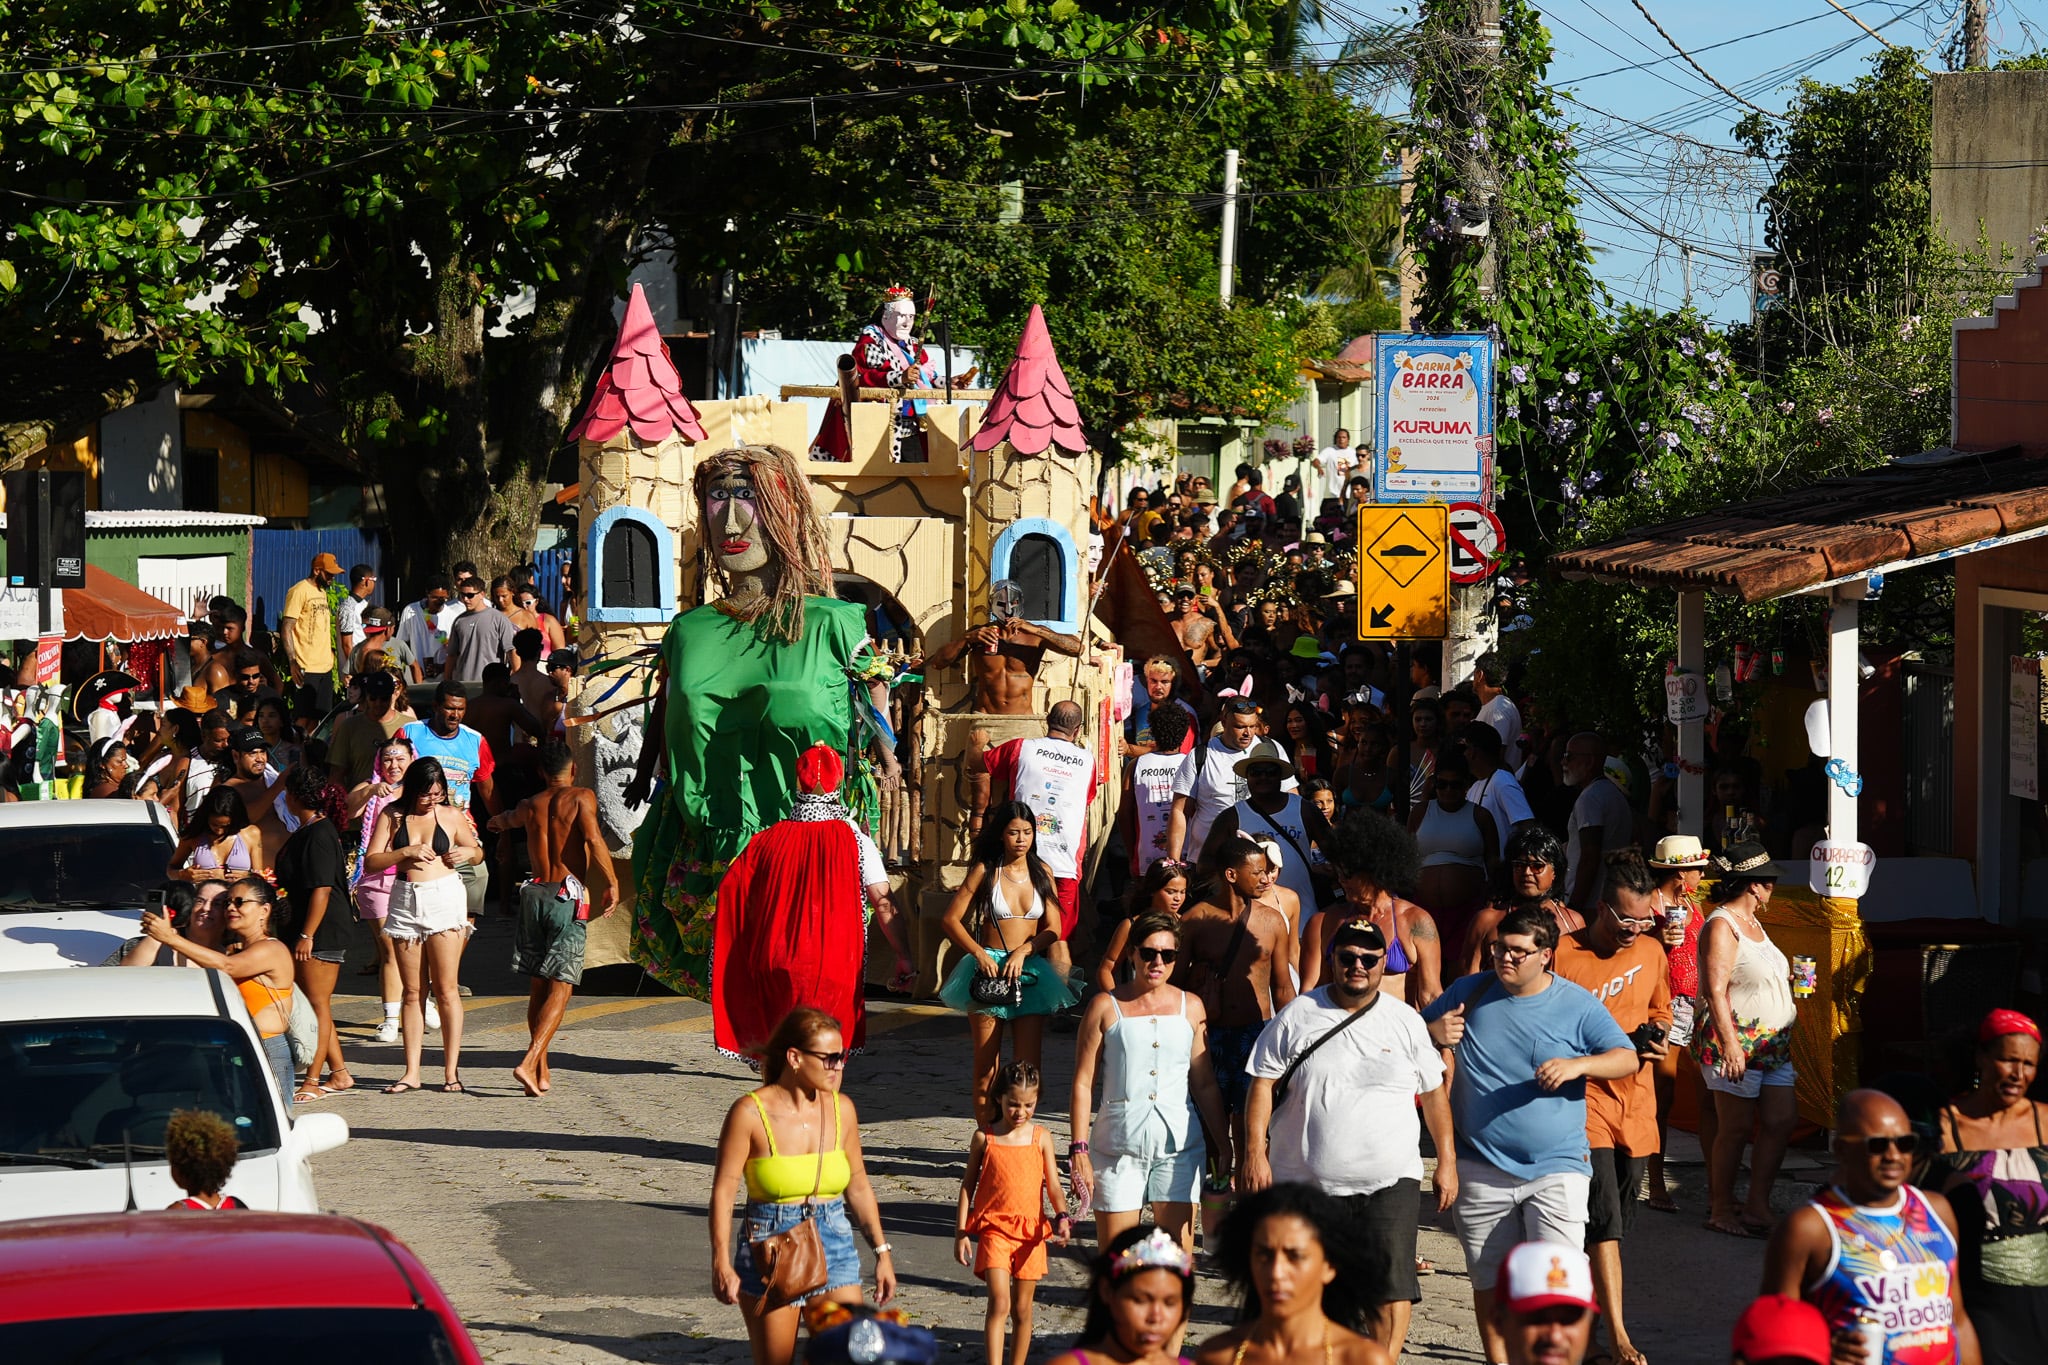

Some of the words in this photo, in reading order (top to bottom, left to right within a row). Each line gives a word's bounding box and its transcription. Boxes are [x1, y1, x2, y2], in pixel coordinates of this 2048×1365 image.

[1416, 362, 1451, 372] CARNA
[1402, 373, 1464, 389] BARRA
[1393, 420, 1473, 435] KURUMA
[1452, 521, 1482, 567] E
[1036, 748, 1084, 767] PRODUÇÃO
[1862, 1276, 1908, 1305] Vai
